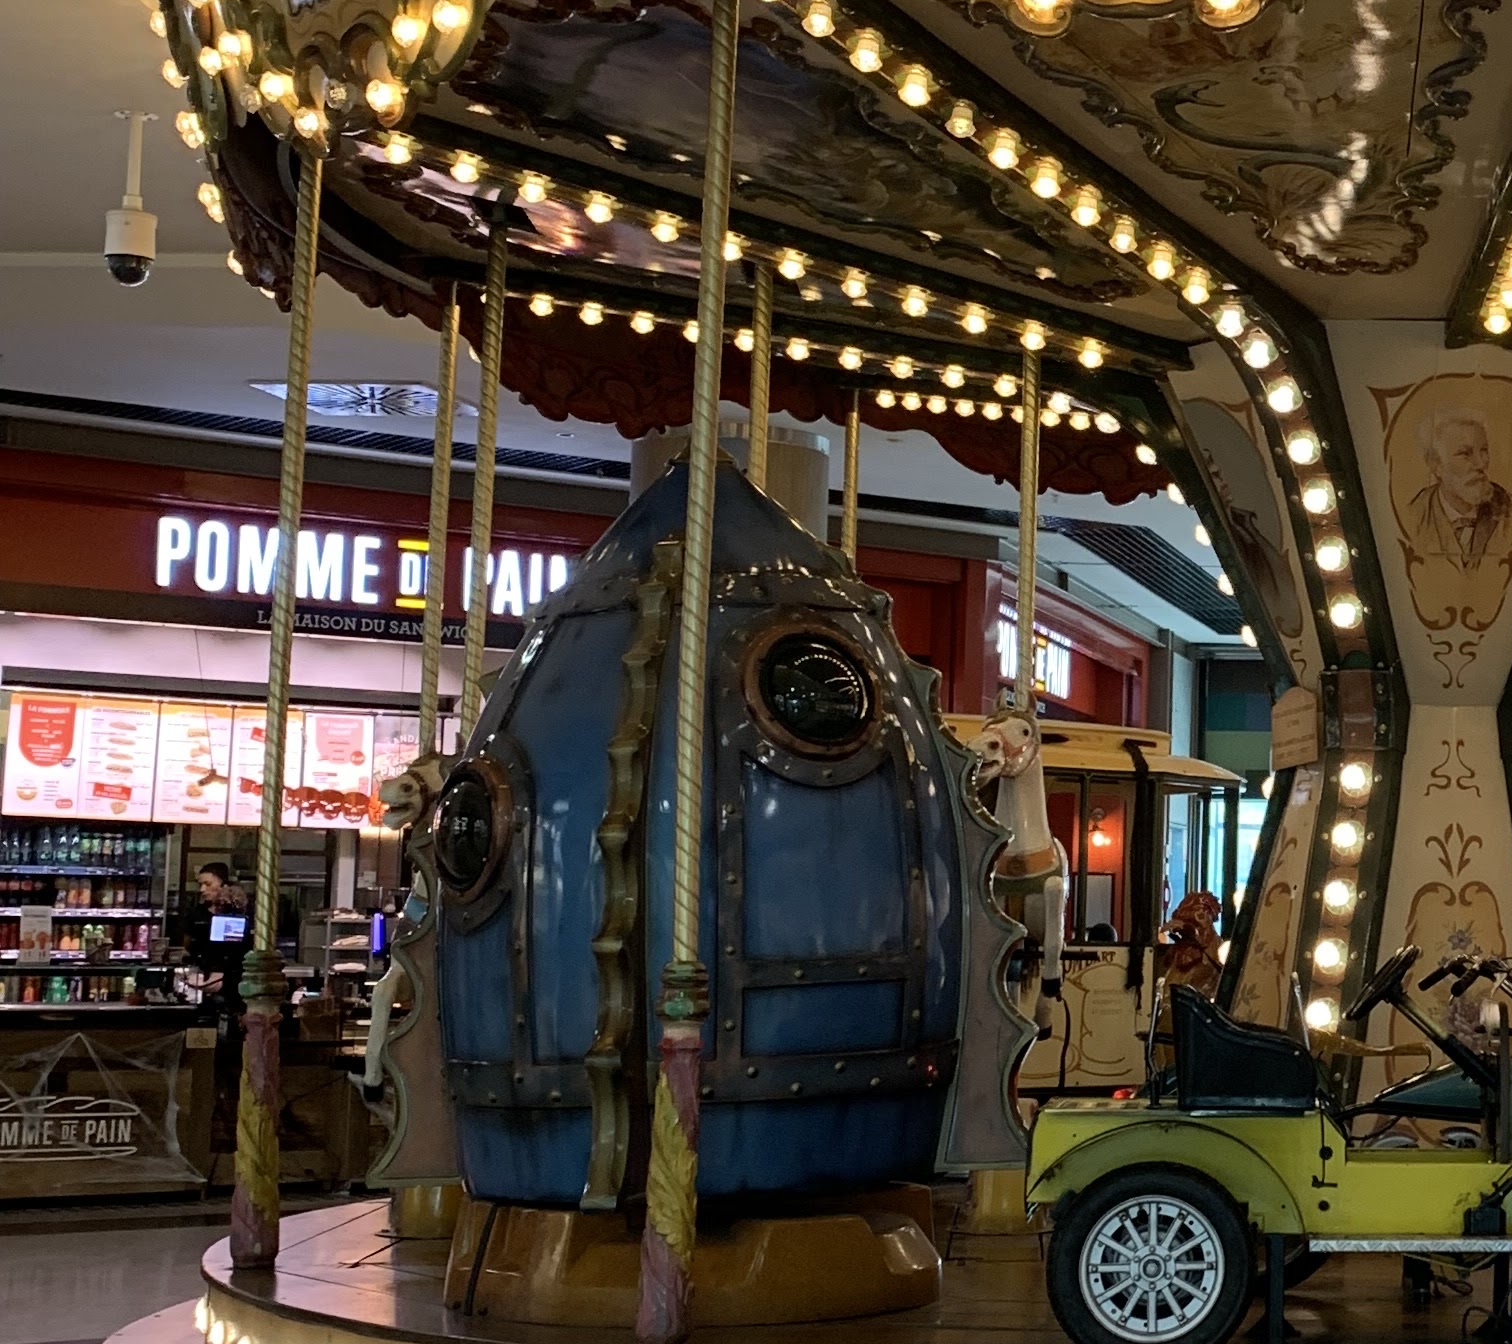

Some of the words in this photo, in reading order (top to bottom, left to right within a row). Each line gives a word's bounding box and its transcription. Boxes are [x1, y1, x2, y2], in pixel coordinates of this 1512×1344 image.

[155, 515, 383, 605] POMME
[398, 551, 431, 596] D
[360, 618, 386, 634] DU
[84, 1118, 132, 1145] PAIN
